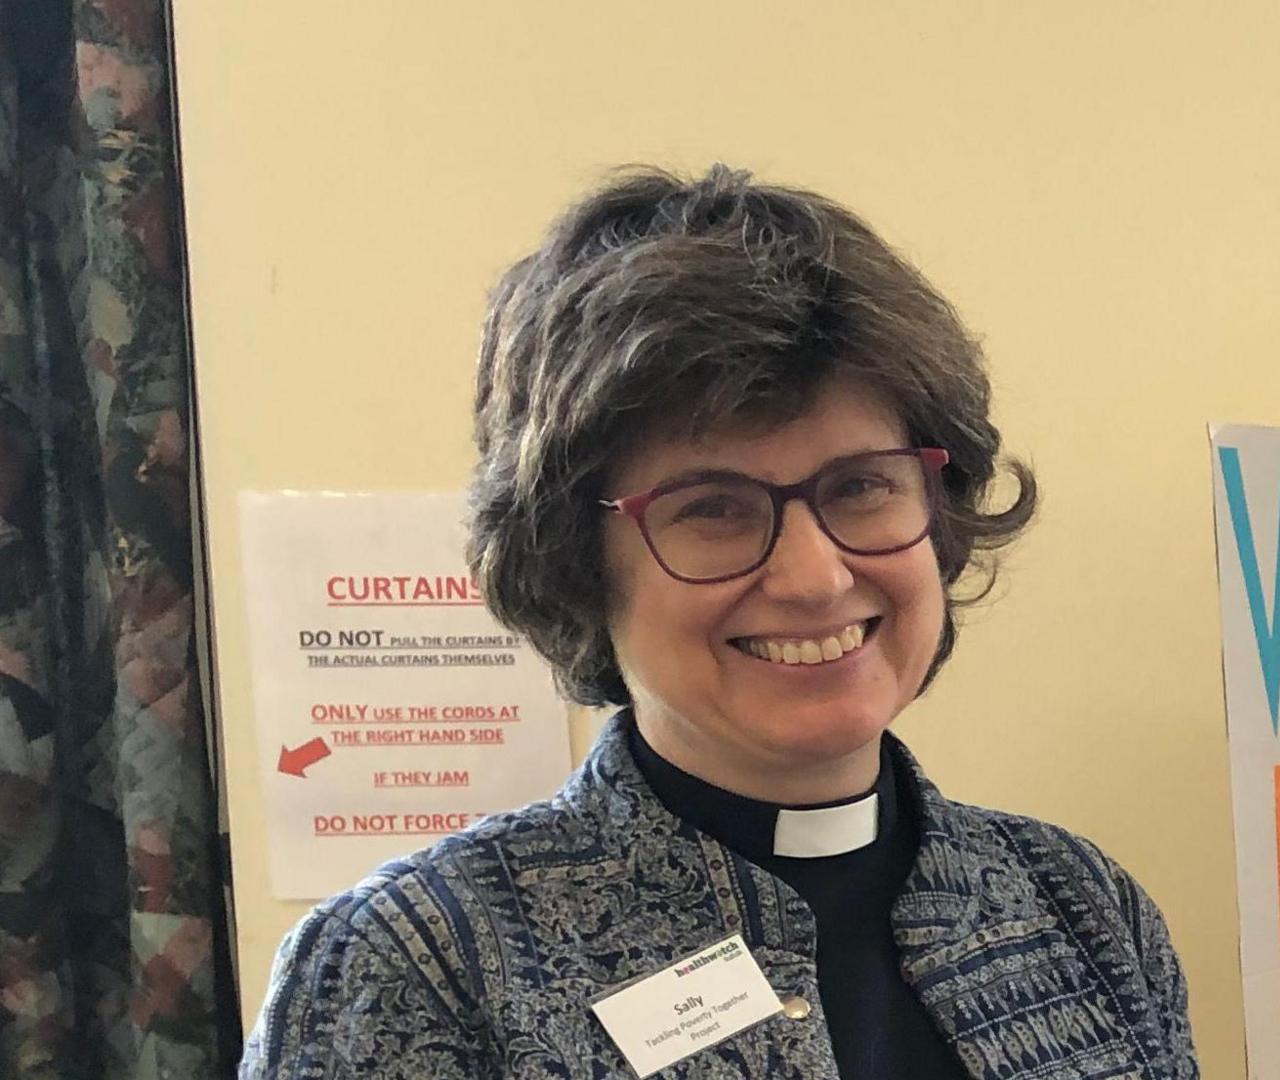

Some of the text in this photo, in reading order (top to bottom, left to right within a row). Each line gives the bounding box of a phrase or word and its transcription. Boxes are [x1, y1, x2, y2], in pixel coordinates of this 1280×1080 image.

[327, 576, 481, 600] CURTAINS
[299, 630, 331, 647] DO
[339, 630, 385, 647] NOT
[390, 636, 420, 646] PULL
[422, 636, 442, 646] THE
[445, 636, 503, 646] CURTAINS
[308, 654, 515, 666] THE ACTUAL CURTAINS THEMSELVES
[311, 704, 520, 721] ONLY USE THE CORDS AT
[331, 728, 504, 744] THE RIGHT HAND SIDE
[374, 771, 469, 785] IF THEY JAM
[314, 813, 469, 832] DO NOT FORCE
[673, 995, 704, 1016] Sally
[645, 991, 749, 1048] Tackling Poverty Together
[690, 1021, 721, 1041] Project
